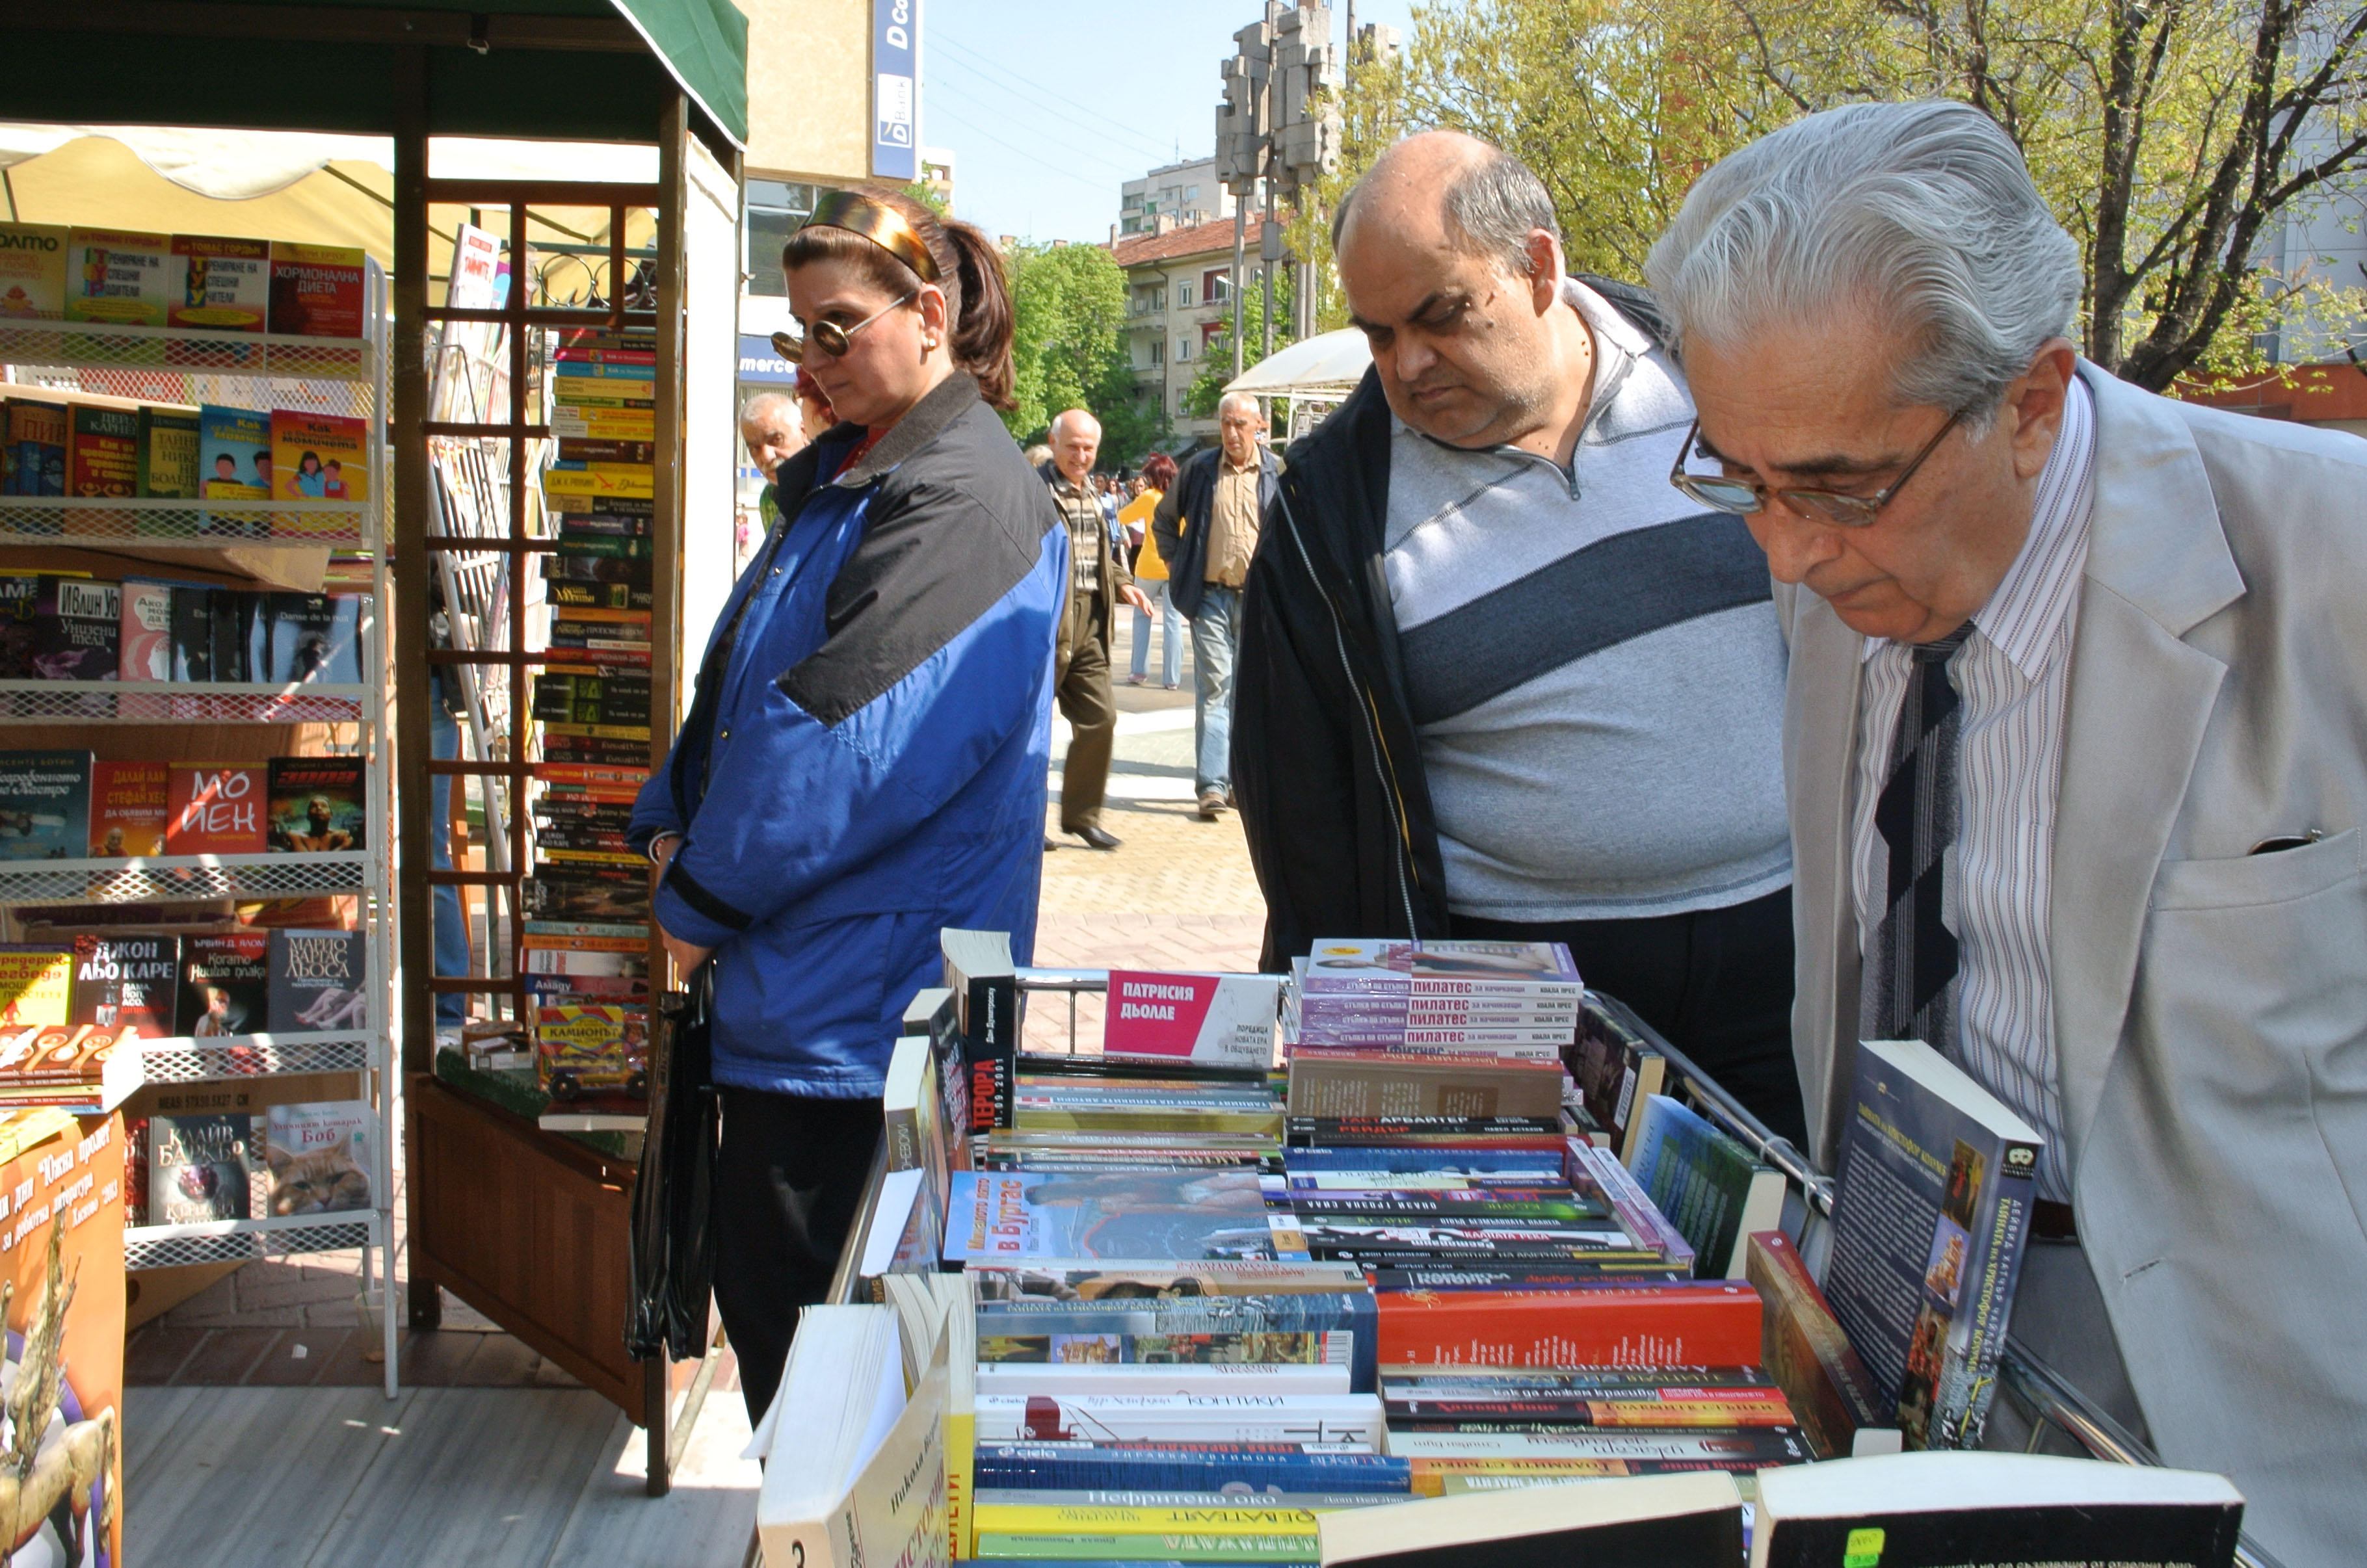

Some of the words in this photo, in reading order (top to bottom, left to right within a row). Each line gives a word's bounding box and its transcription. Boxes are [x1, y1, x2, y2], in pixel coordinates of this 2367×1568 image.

[192, 242, 223, 253] ТОМАС
[276, 266, 360, 284] ХОРМОНАЛНА
[297, 281, 337, 295] ДИЕТА
[280, 611, 304, 621] Danse
[192, 770, 250, 800] МО
[108, 791, 148, 805] СТЕФАН
[194, 939, 226, 948] ЪРВИН
[289, 937, 348, 952] МАРИО
[93, 942, 158, 963] ДЖОН
[289, 950, 348, 965] ВАРГАС
[79, 963, 120, 980] ЛЬО
[123, 961, 174, 980] КАРЕ
[285, 962, 350, 978] ЛЬОСА
[535, 980, 572, 993] Амаду
[1122, 982, 1195, 1001] ПАТРИСИЯ
[1414, 981, 1473, 995] пилатес
[1120, 1003, 1175, 1021] ДЬОЛАЕ
[1411, 999, 1470, 1012] пилатес
[1409, 1013, 1467, 1026] пилатес
[1236, 1024, 1269, 1034] ПОРЕДИЦА
[1407, 1030, 1465, 1043] пилатес
[972, 1058, 996, 1129] ТЕРОРА
[994, 1058, 1005, 1128] 11.09.2001
[169, 1123, 234, 1146] КЛАЙВ
[301, 1128, 337, 1144] Боб
[989, 1181, 1030, 1236] Бургас
[1992, 1197, 2011, 1246] ТАЙНАТА
[2004, 1199, 2022, 1250] ДЕЙВИД
[996, 1241, 1021, 1252] в
[1976, 1261, 1998, 1327] ХРИСТОФОР
[1016, 1447, 1057, 1459] ciela
[1089, 1491, 1228, 1507] Нефритено
[1233, 1494, 1277, 1505] око
